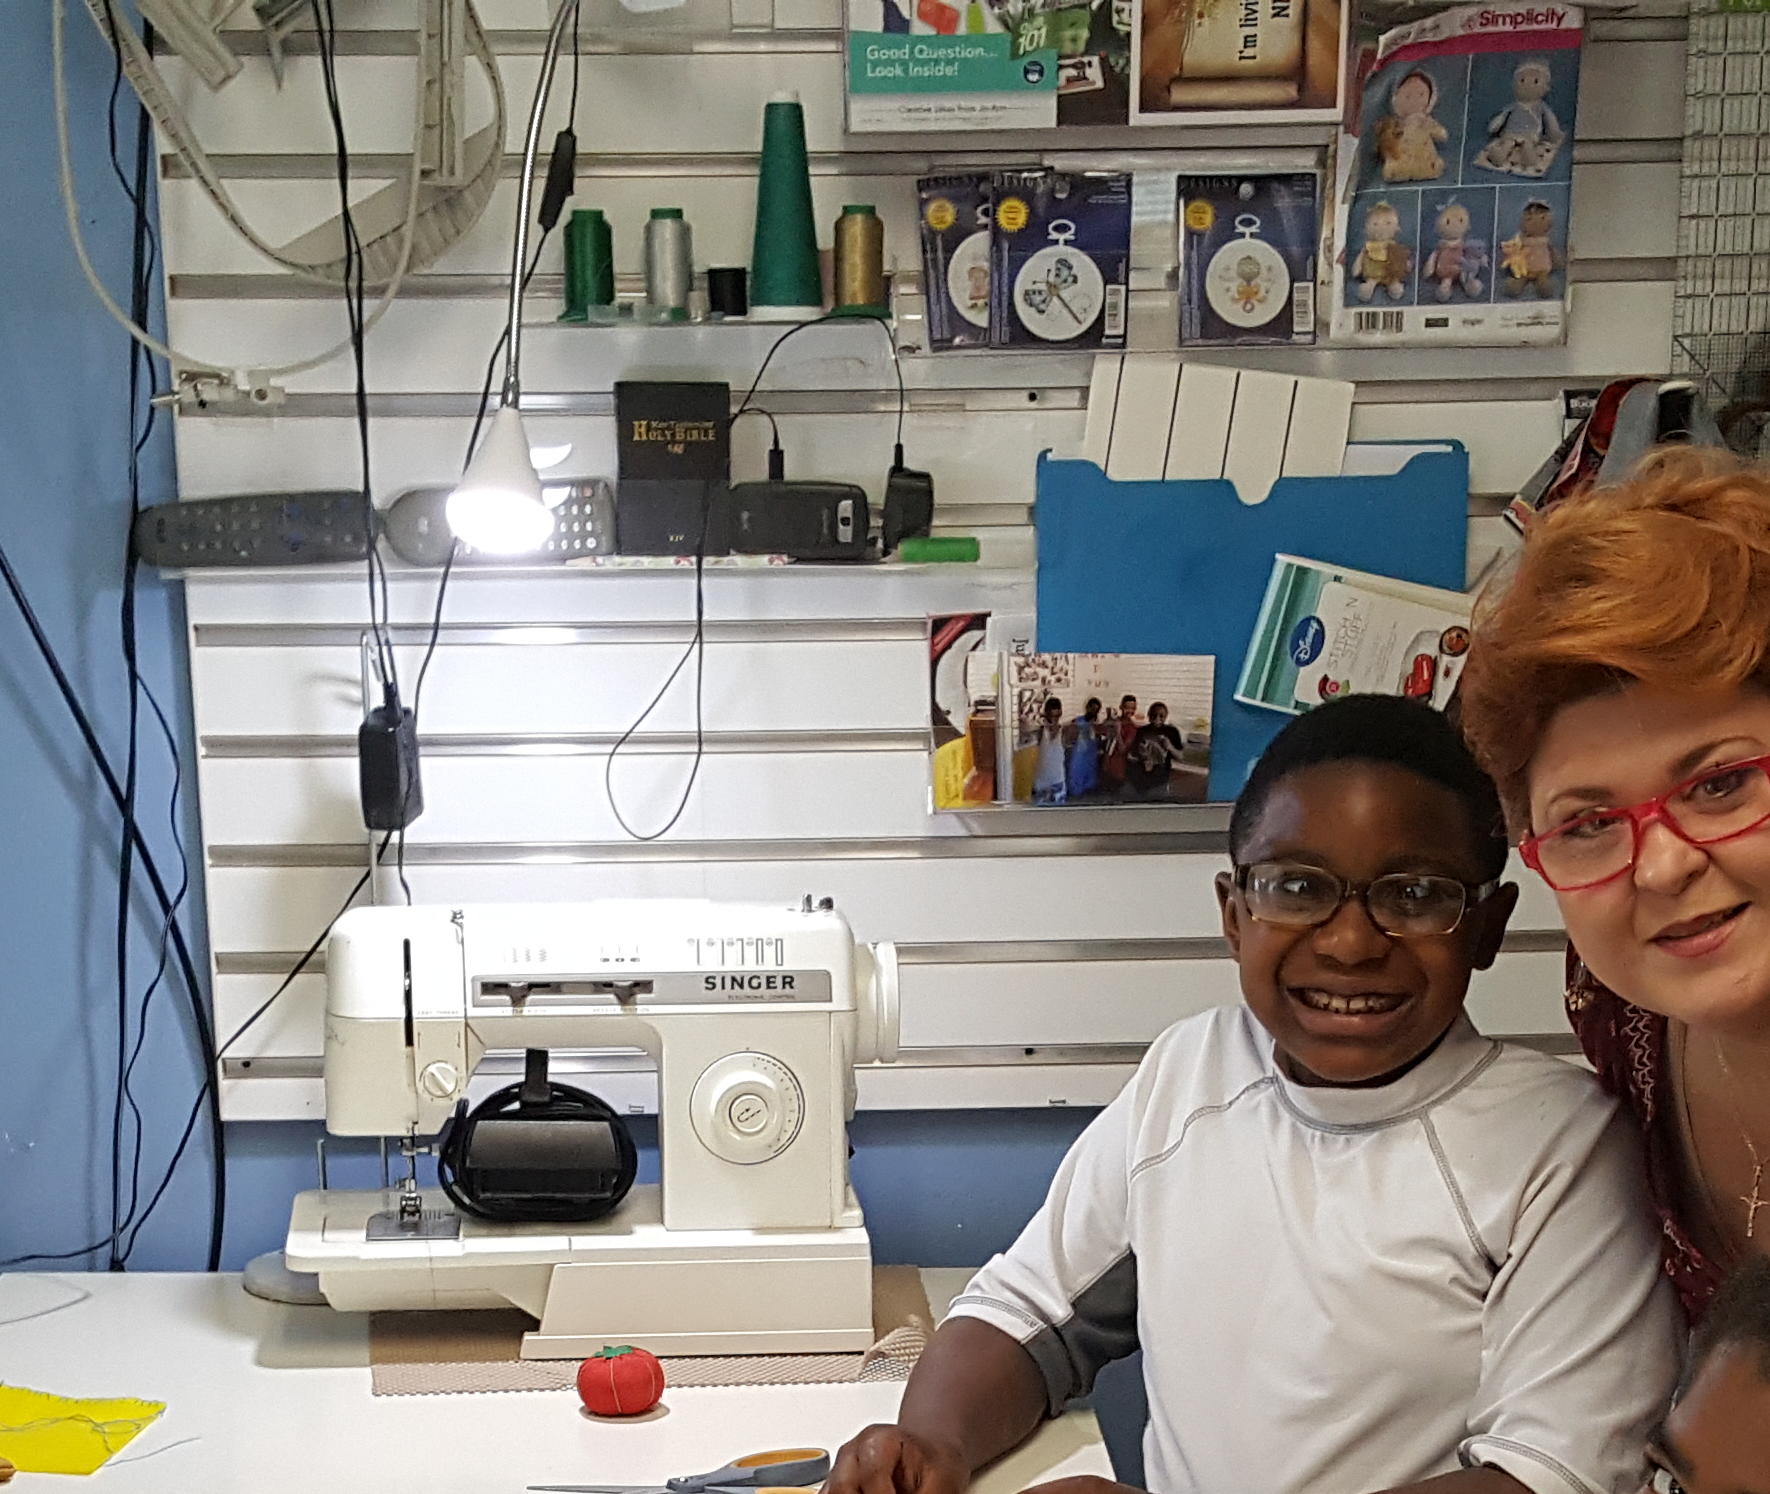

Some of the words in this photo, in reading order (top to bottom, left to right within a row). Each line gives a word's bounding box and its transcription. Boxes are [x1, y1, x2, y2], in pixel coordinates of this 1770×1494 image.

[1479, 8, 1569, 30] Simplicity
[1018, 26, 1047, 55] 101
[1239, 33, 1257, 62] I'm
[866, 45, 910, 60] Good
[914, 44, 999, 60] Question...
[866, 62, 904, 77] Look
[909, 61, 959, 77] Inside!
[632, 420, 674, 442] HOLY
[675, 428, 717, 442] BIBLE
[1293, 618, 1322, 662] Disney
[704, 974, 797, 992] SINGER
